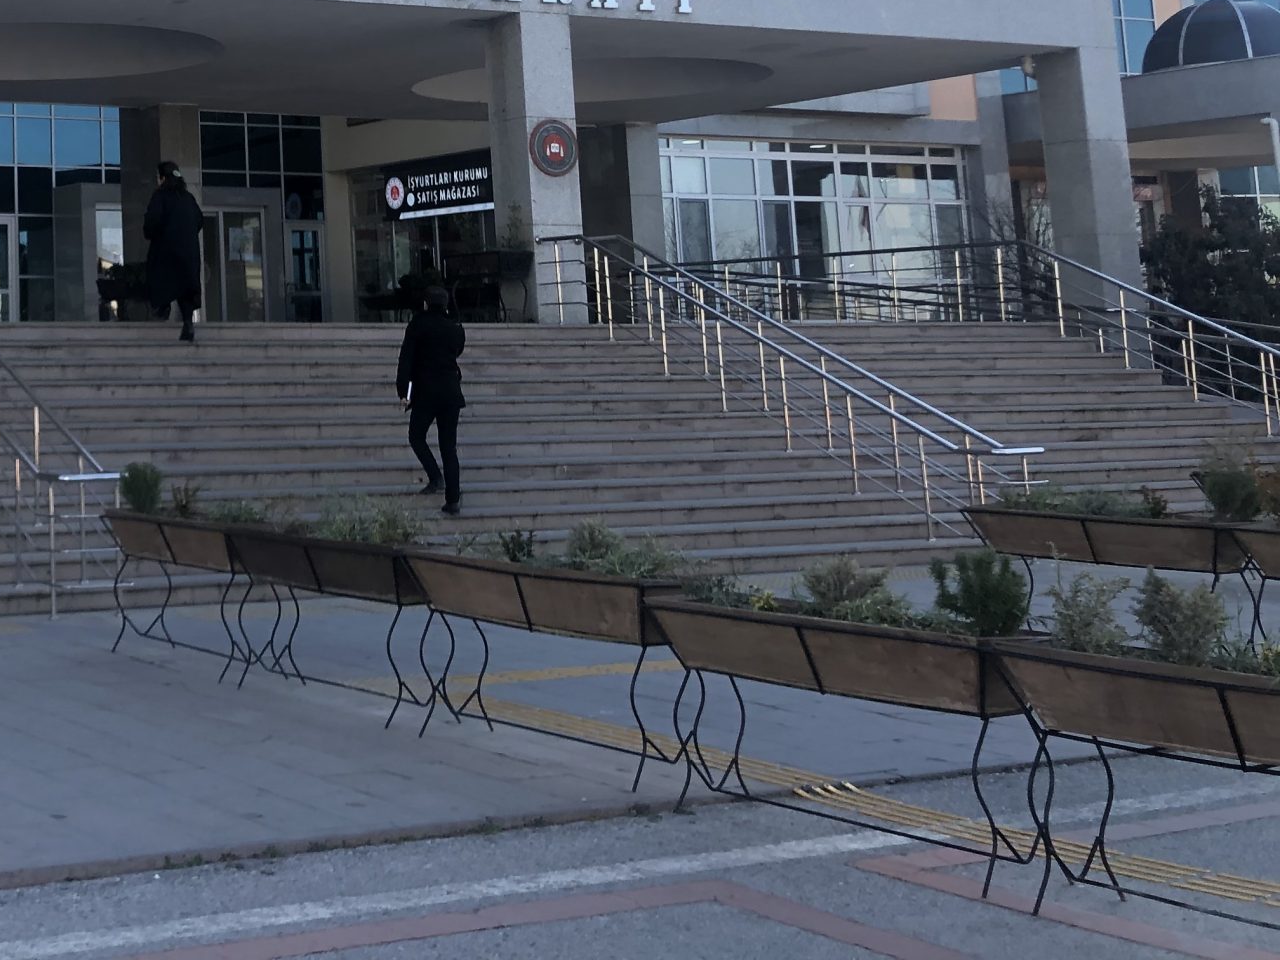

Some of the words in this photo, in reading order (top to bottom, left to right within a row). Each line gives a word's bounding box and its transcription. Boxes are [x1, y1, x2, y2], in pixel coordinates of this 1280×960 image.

[453, 166, 488, 183] KURUMU
[417, 190, 438, 205] SATIŞ
[439, 185, 480, 201] MAĞAZASI
